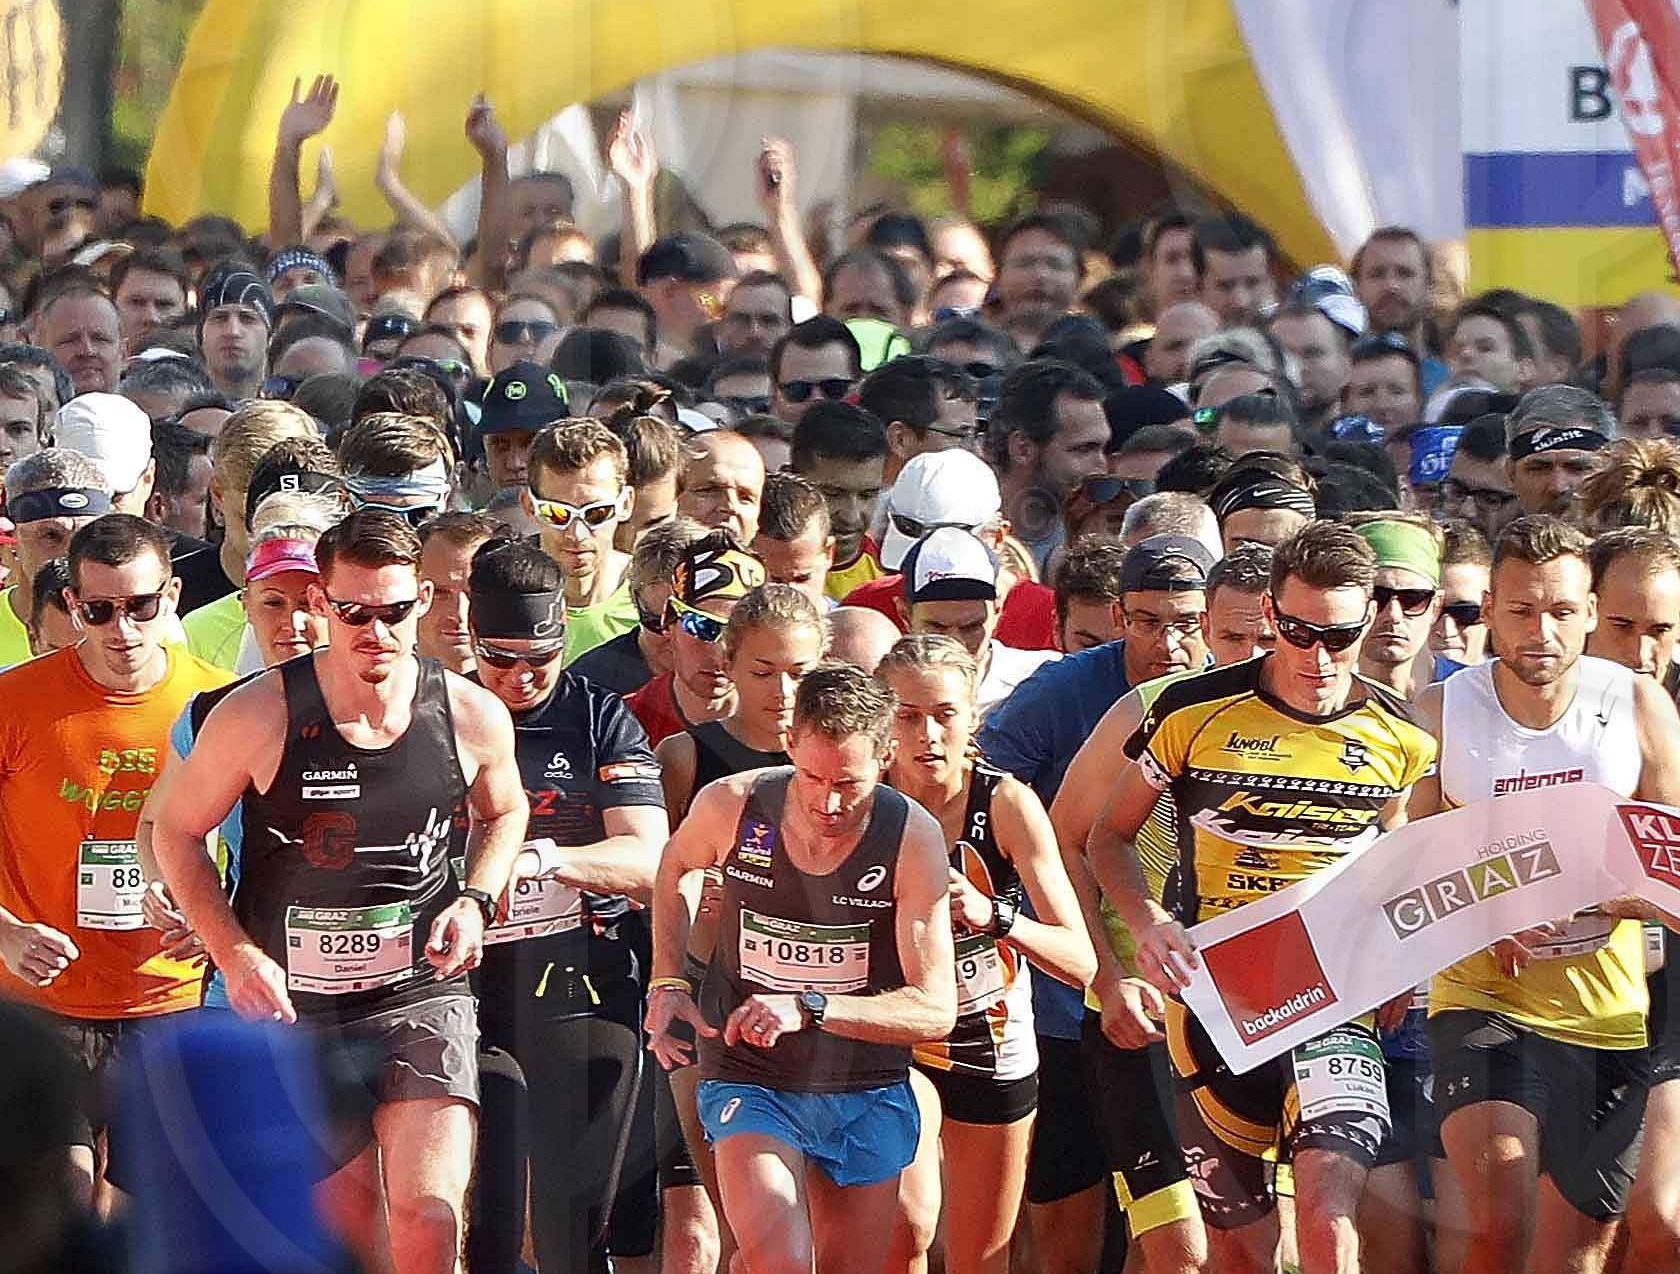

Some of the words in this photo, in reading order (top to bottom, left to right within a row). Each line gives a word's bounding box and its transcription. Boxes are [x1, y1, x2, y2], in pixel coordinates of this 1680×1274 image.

[301, 770, 359, 782] GARMIN
[1477, 828, 1548, 859] HOLDING
[726, 865, 775, 889] GARMIN
[1392, 851, 1554, 932] GRAZ
[318, 933, 381, 956] 8289
[762, 938, 845, 965] 10818
[1241, 984, 1327, 1036] backaldrin
[1326, 1056, 1384, 1084] 8759
